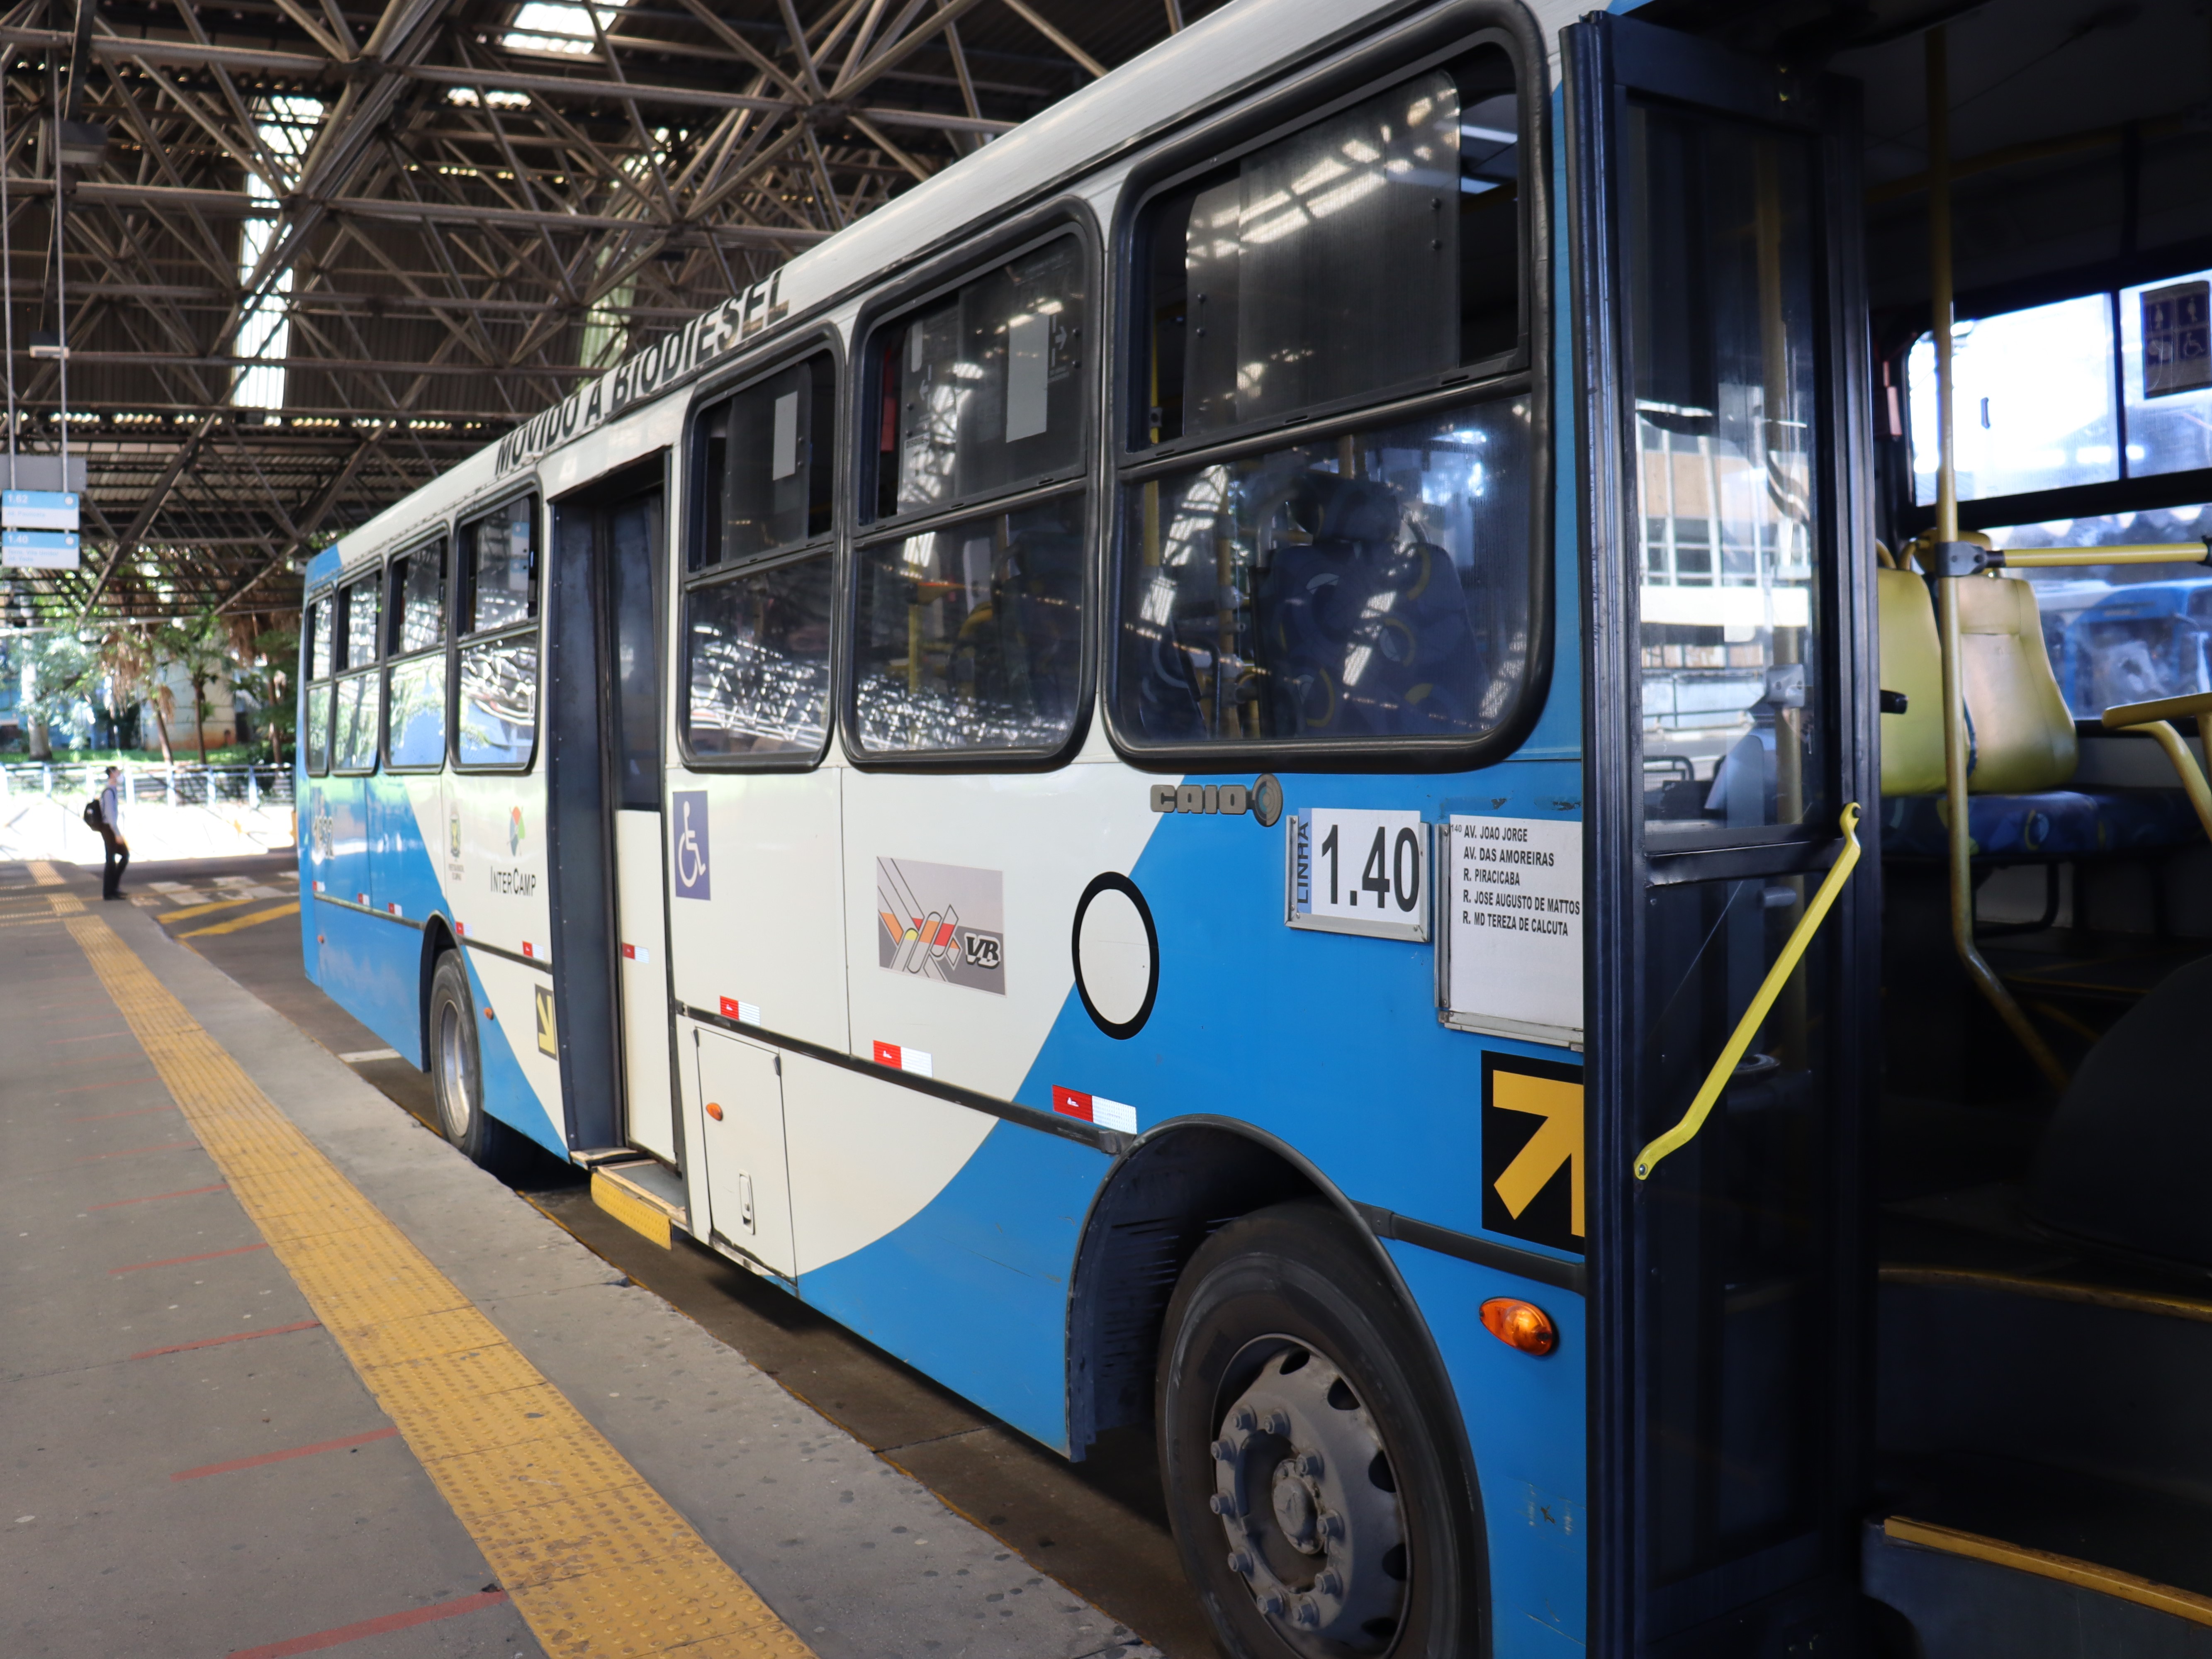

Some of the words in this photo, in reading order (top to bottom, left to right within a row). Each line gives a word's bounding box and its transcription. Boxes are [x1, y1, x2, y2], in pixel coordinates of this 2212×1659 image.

[495, 391, 581, 476] MOVIDO
[585, 376, 603, 427] A
[611, 269, 789, 412] BIODIESEL
[7, 534, 29, 544] 1.40
[1151, 785, 1247, 815] CAIO
[1450, 824, 1462, 833] 140
[1464, 825, 1477, 839] AV.
[1480, 826, 1500, 840] JOAO
[1502, 827, 1528, 842] JORGE
[1297, 822, 1308, 904] LINHA
[1321, 824, 1420, 912] 1.40
[1463, 846, 1476, 860] AV.
[1480, 847, 1497, 862] DAS
[1499, 849, 1554, 867] AMOREIRAS
[1463, 868, 1471, 881] R.
[1475, 868, 1520, 886] PIRACICABA
[1463, 889, 1471, 903] R.
[1475, 891, 1493, 906] JOSE
[1495, 893, 1532, 910] AUGUSTO
[1535, 897, 1545, 912] DE
[1547, 898, 1580, 915] MATTOS
[1463, 910, 1471, 924] R.
[1474, 912, 1484, 926] MD
[1487, 913, 1516, 930] TEREZA
[1519, 917, 1529, 932] DE
[1531, 918, 1568, 937] CALCUTA
[965, 933, 1001, 969] VB
